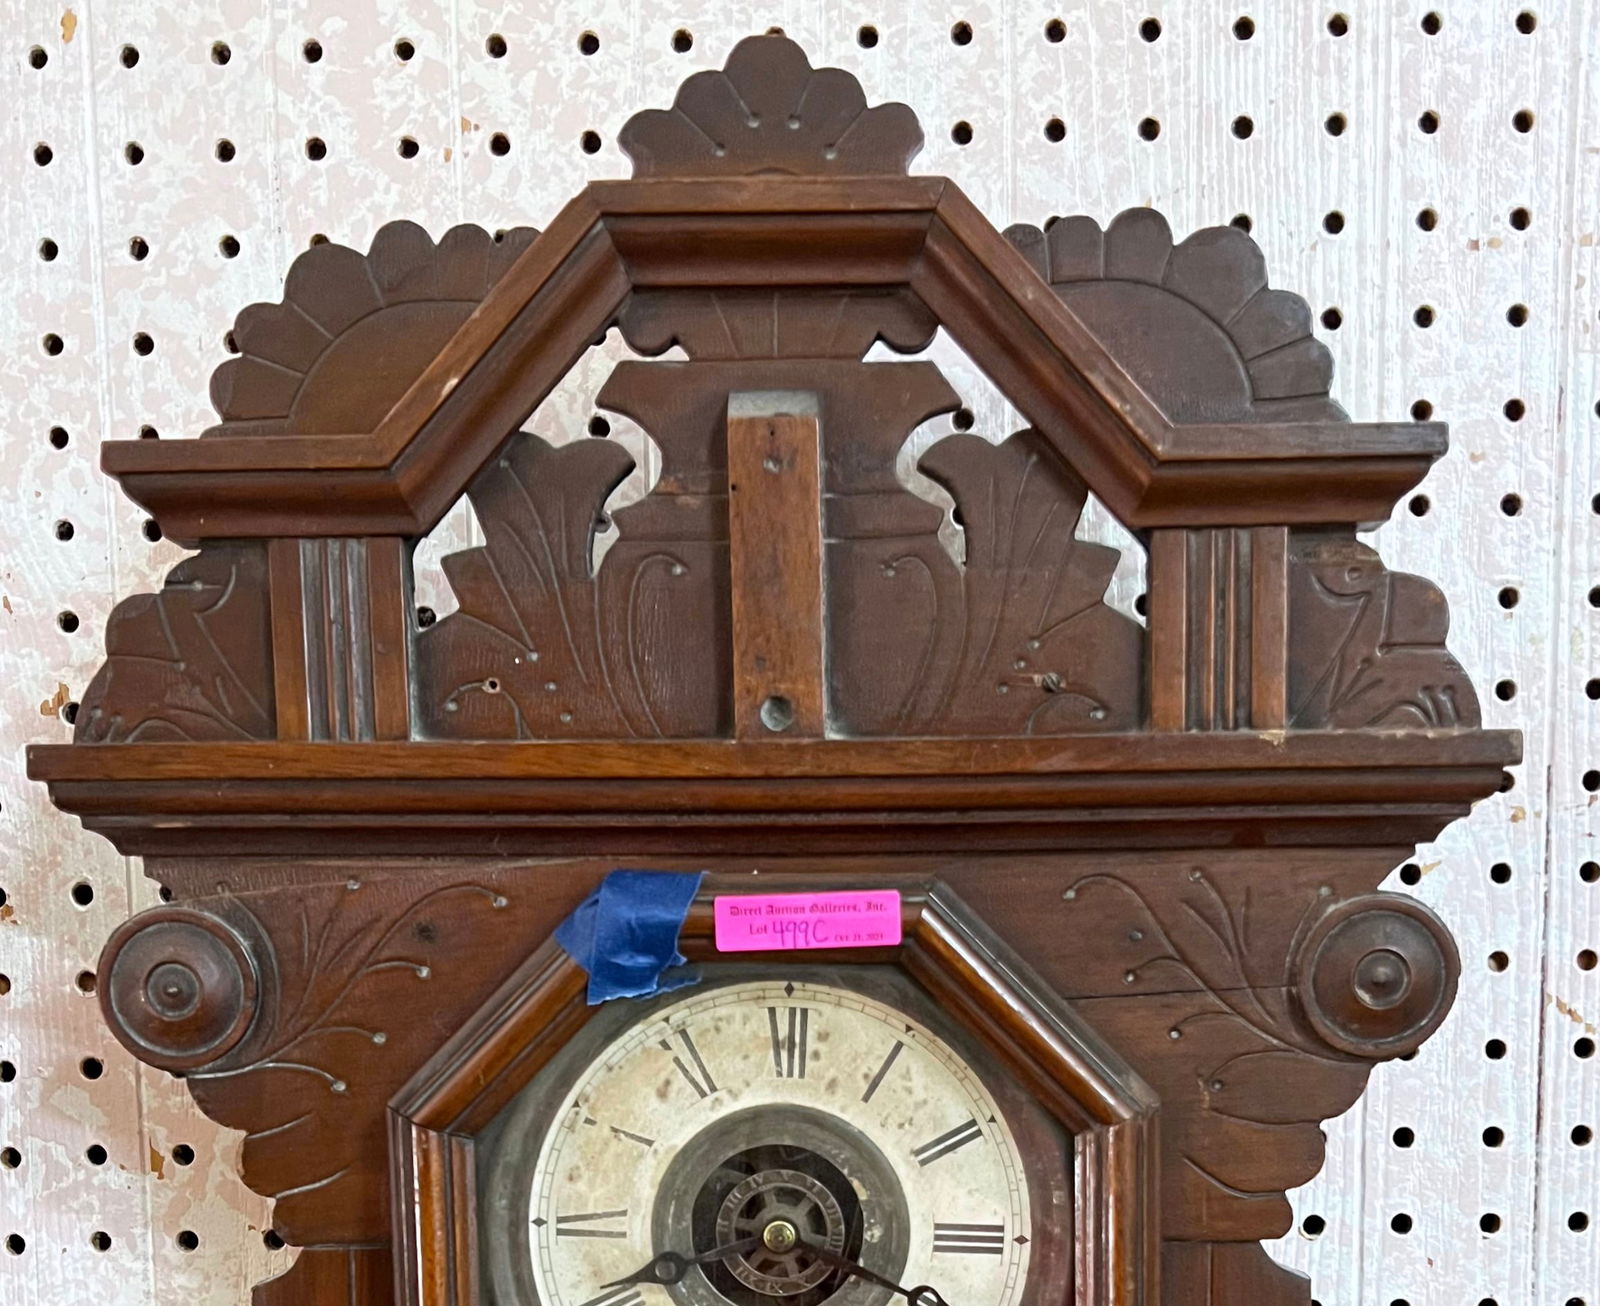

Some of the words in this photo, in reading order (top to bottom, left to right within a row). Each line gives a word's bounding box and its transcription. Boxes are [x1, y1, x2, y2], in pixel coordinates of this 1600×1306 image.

[729, 905, 762, 917] Direct
[765, 904, 806, 916] Auction
[809, 902, 861, 914] Galleries,
[864, 901, 888, 912] Inc.
[749, 923, 768, 935] Lot
[772, 919, 828, 949] 499C
[860, 1039, 905, 1104] I
[911, 1110, 988, 1168] II
[932, 1219, 1006, 1259] III
